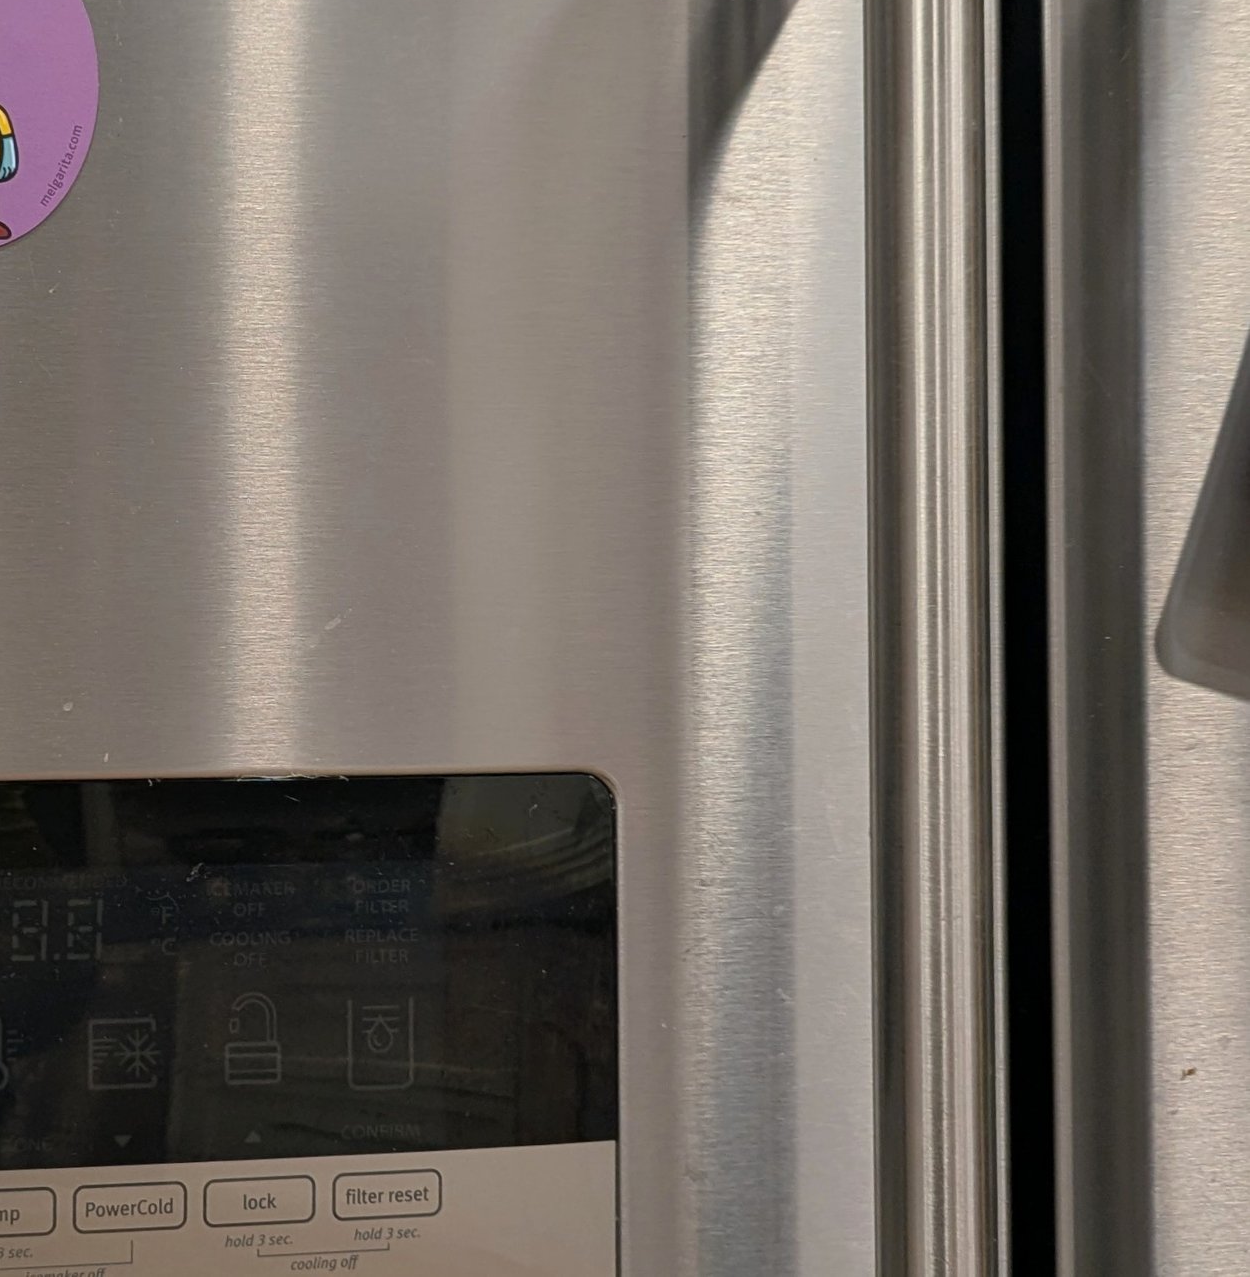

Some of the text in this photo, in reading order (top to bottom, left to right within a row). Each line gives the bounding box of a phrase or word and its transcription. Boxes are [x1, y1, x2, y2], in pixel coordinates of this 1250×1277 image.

[40, 124, 83, 208] melgarita.com
[233, 902, 265, 918] OFF
[210, 931, 292, 947] COOLING
[344, 927, 419, 943] REPLACE
[355, 948, 410, 964] FILTER
[243, 1194, 277, 1210] lock
[346, 1186, 429, 1205] filter reset
[85, 1198, 174, 1218] PowerCold
[225, 1233, 294, 1248] hold 3 sec.
[353, 1227, 421, 1242] hold 3 sec.
[8, 1247, 34, 1260] sec.
[290, 1254, 360, 1272] cooling off
